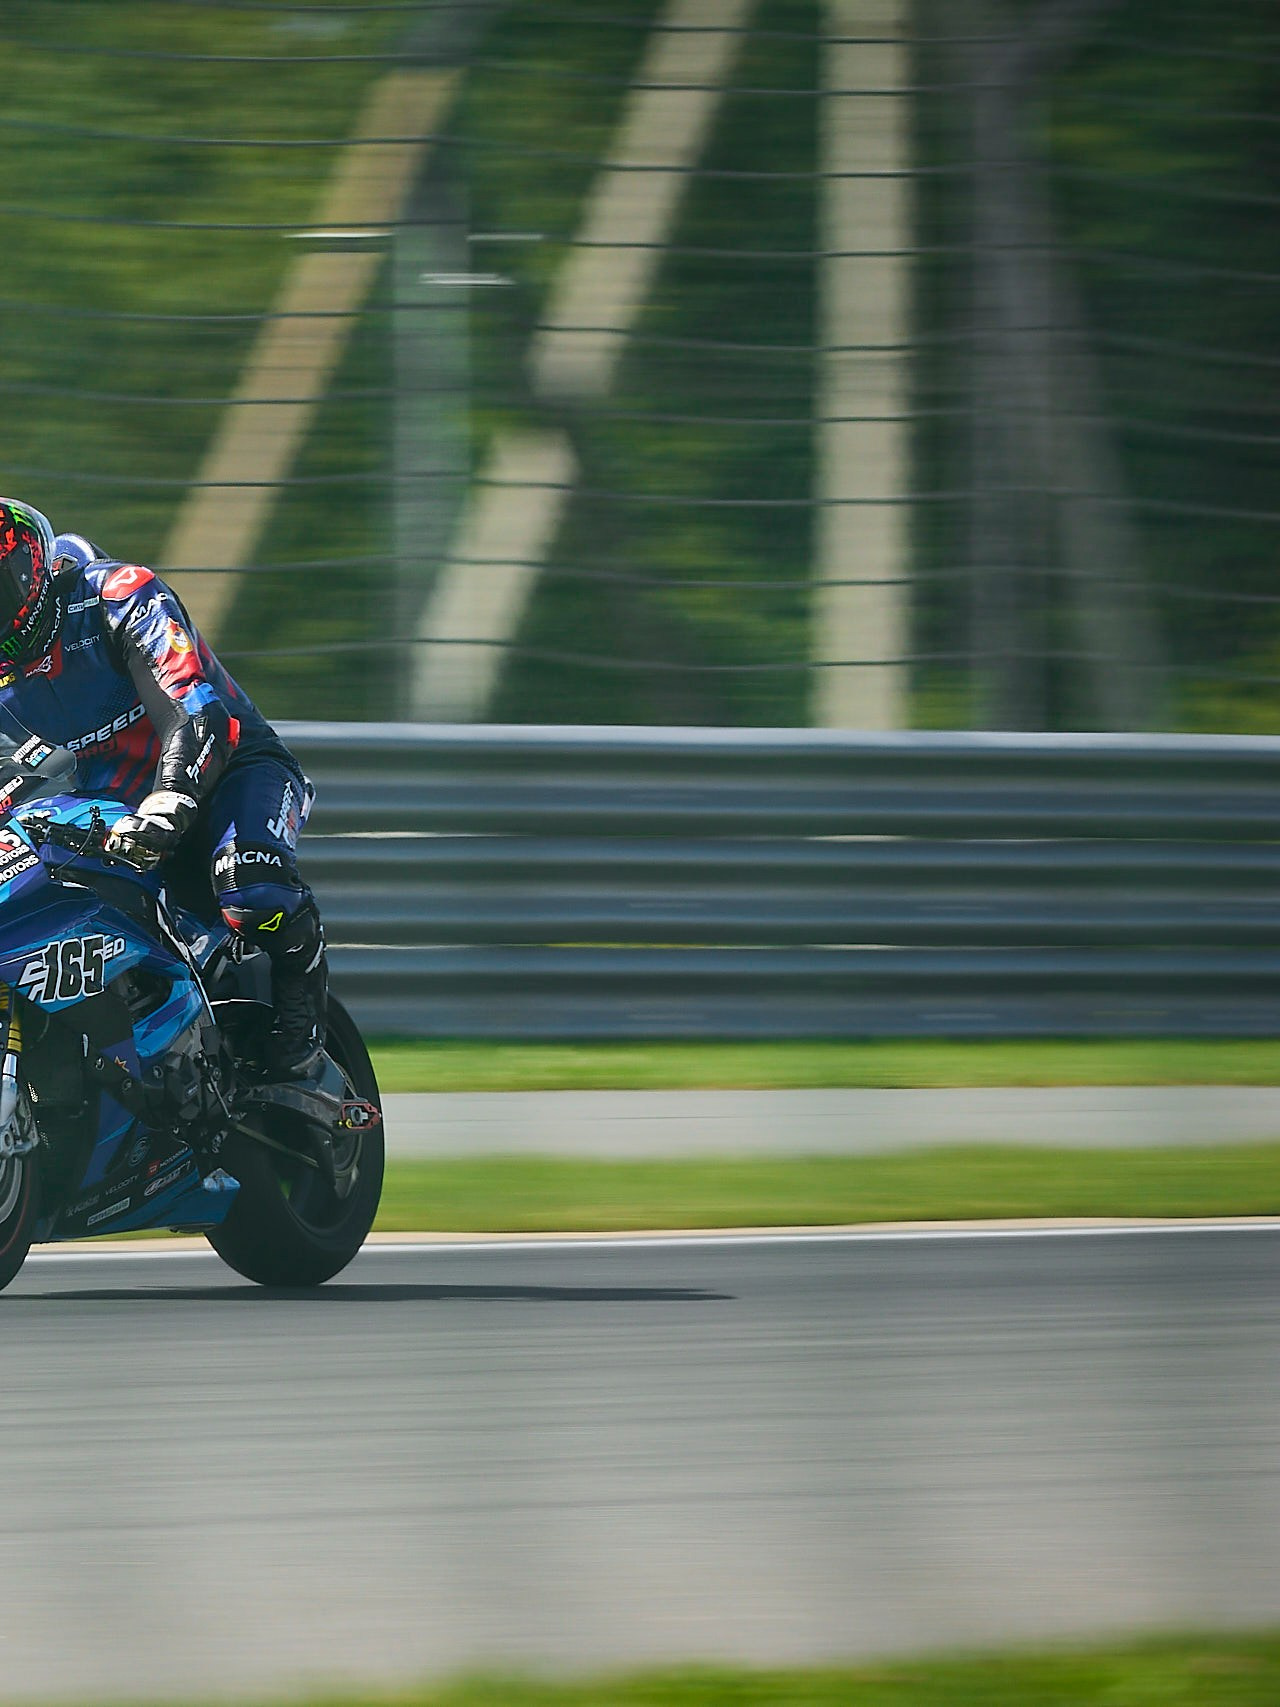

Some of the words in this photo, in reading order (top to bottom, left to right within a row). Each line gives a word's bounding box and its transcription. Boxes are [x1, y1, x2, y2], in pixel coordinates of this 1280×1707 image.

[42, 597, 61, 652] MACNA
[64, 634, 101, 652] VELOCITY
[66, 703, 146, 753] SPEED
[10, 734, 42, 765] MOTORING
[215, 850, 283, 876] MACNA
[39, 933, 105, 1004] 165
